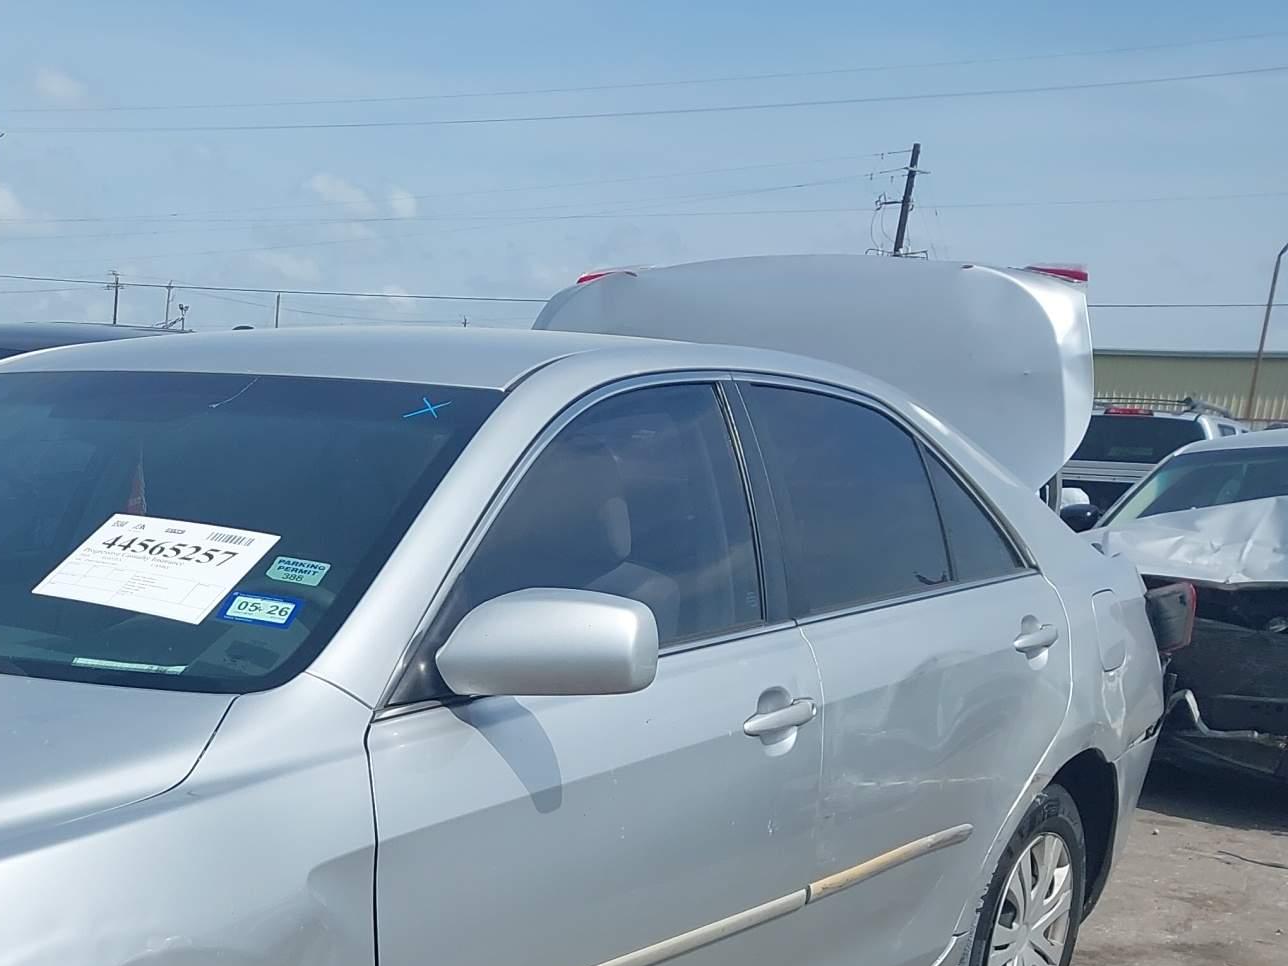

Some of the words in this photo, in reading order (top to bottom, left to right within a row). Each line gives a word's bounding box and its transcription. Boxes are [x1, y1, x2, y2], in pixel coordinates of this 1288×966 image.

[101, 534, 239, 567] 44565257
[276, 565, 319, 576] PERMIT
[277, 559, 326, 571] PARKING
[266, 604, 291, 617] 26
